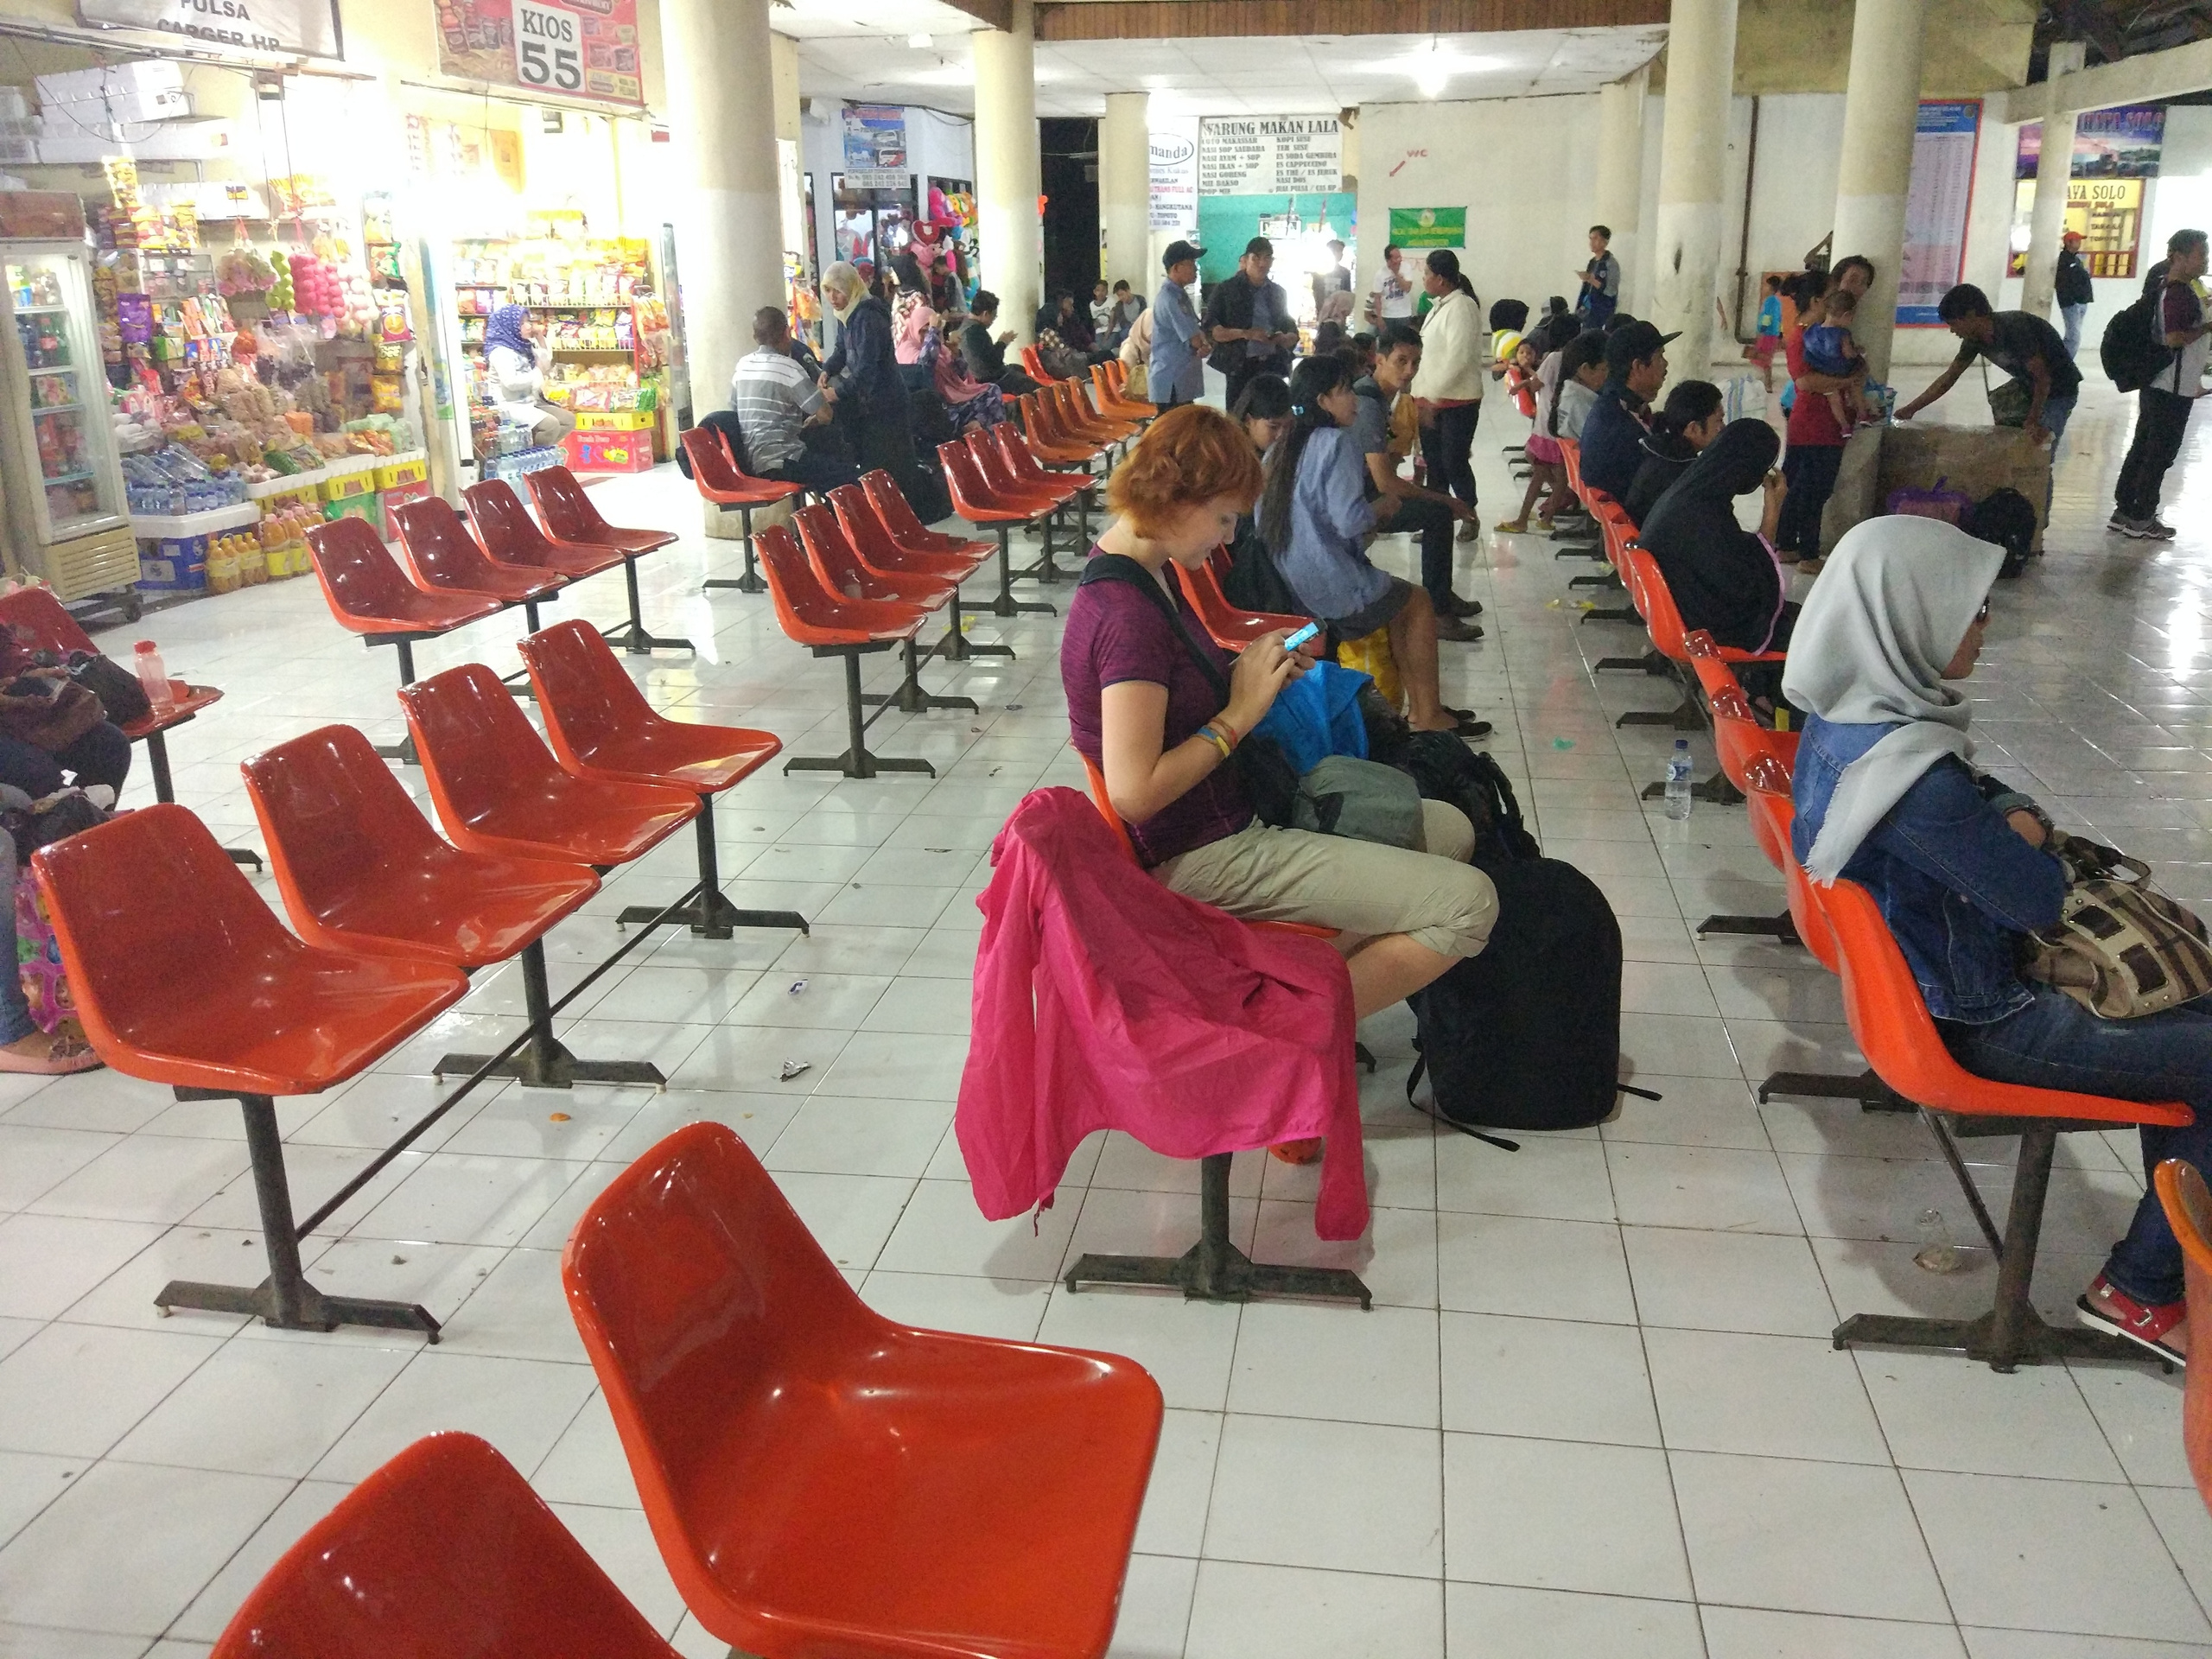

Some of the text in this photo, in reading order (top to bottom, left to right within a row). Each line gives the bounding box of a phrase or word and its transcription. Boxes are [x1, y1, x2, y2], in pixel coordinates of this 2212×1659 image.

[157, 18, 280, 51] CARGER HP
[520, 8, 573, 42] KIOS
[521, 40, 581, 90] 55
[1202, 120, 1338, 136] WARUNG MAKAN LALA
[1407, 149, 1428, 157] WC
[2092, 185, 2126, 200] SOLO
